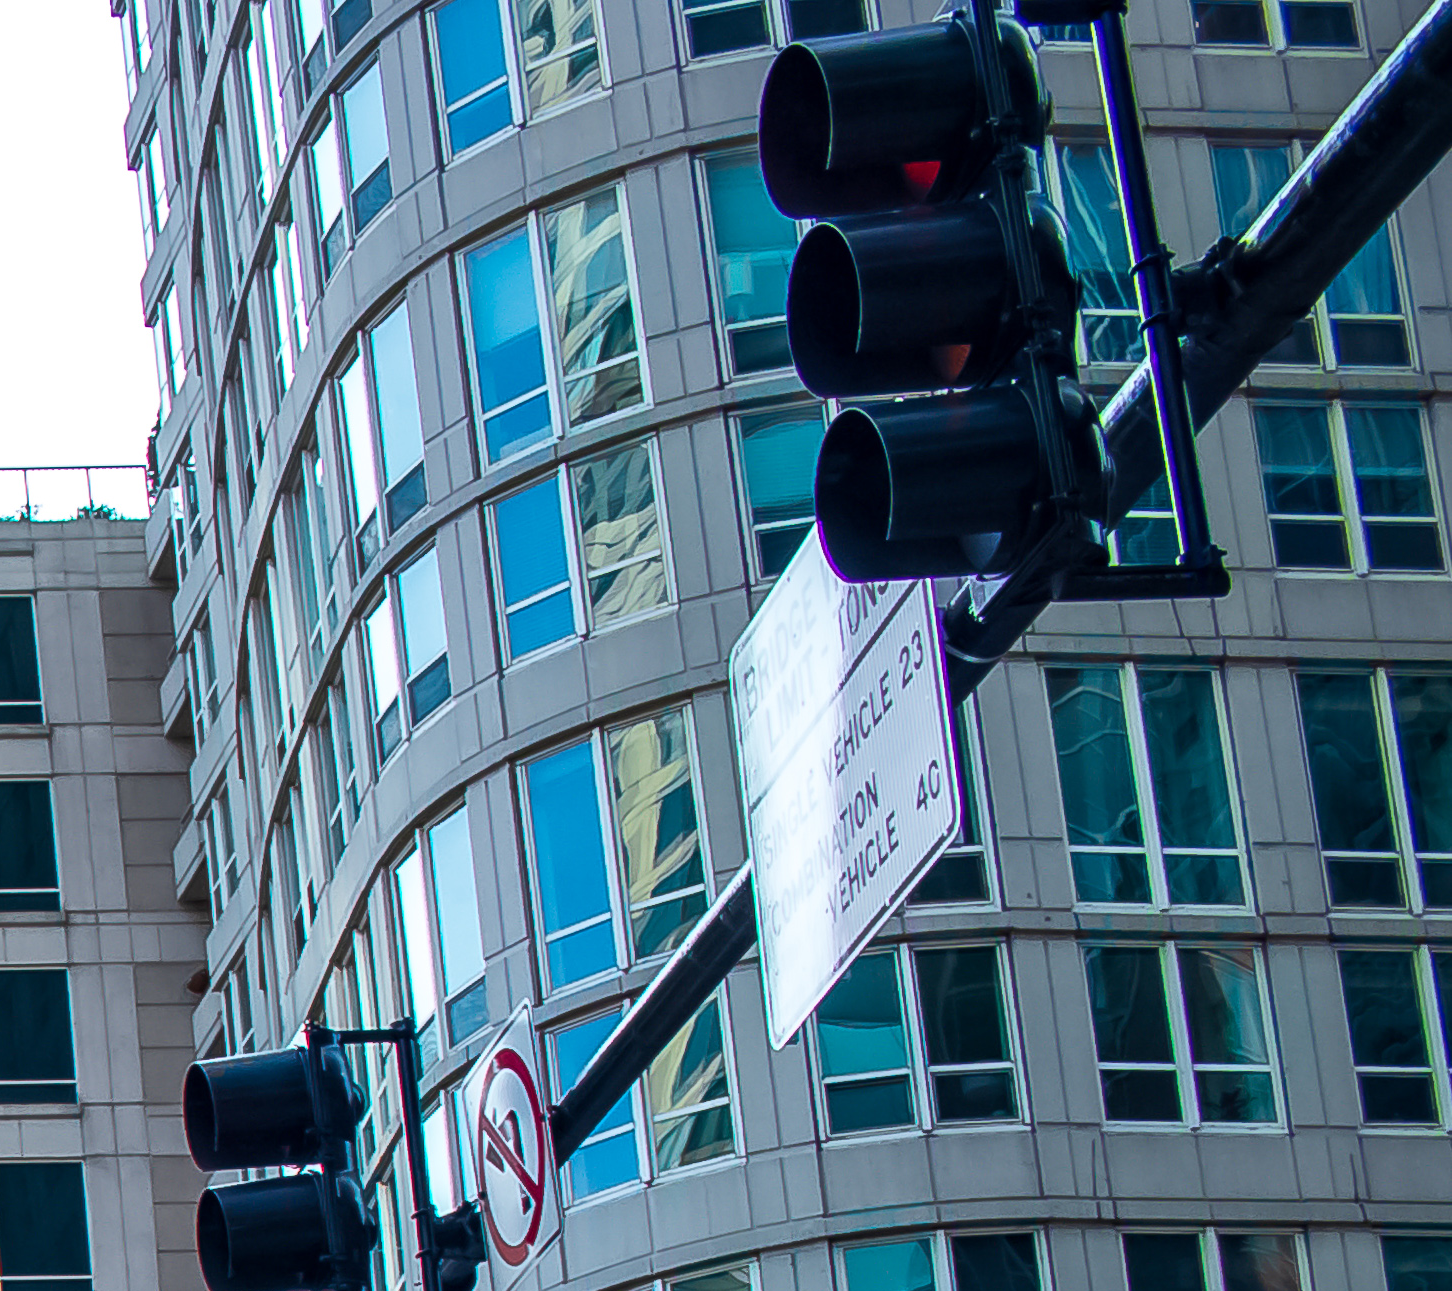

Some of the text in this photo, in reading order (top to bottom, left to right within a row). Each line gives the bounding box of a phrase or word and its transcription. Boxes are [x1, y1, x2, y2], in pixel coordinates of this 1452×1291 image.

[743, 576, 817, 719] BRIDGE
[766, 643, 814, 752] LIMIT
[763, 630, 924, 870] SINGLE VEHICLE 23
[770, 772, 879, 937] COMBINATION
[827, 810, 900, 923] VEHICLE
